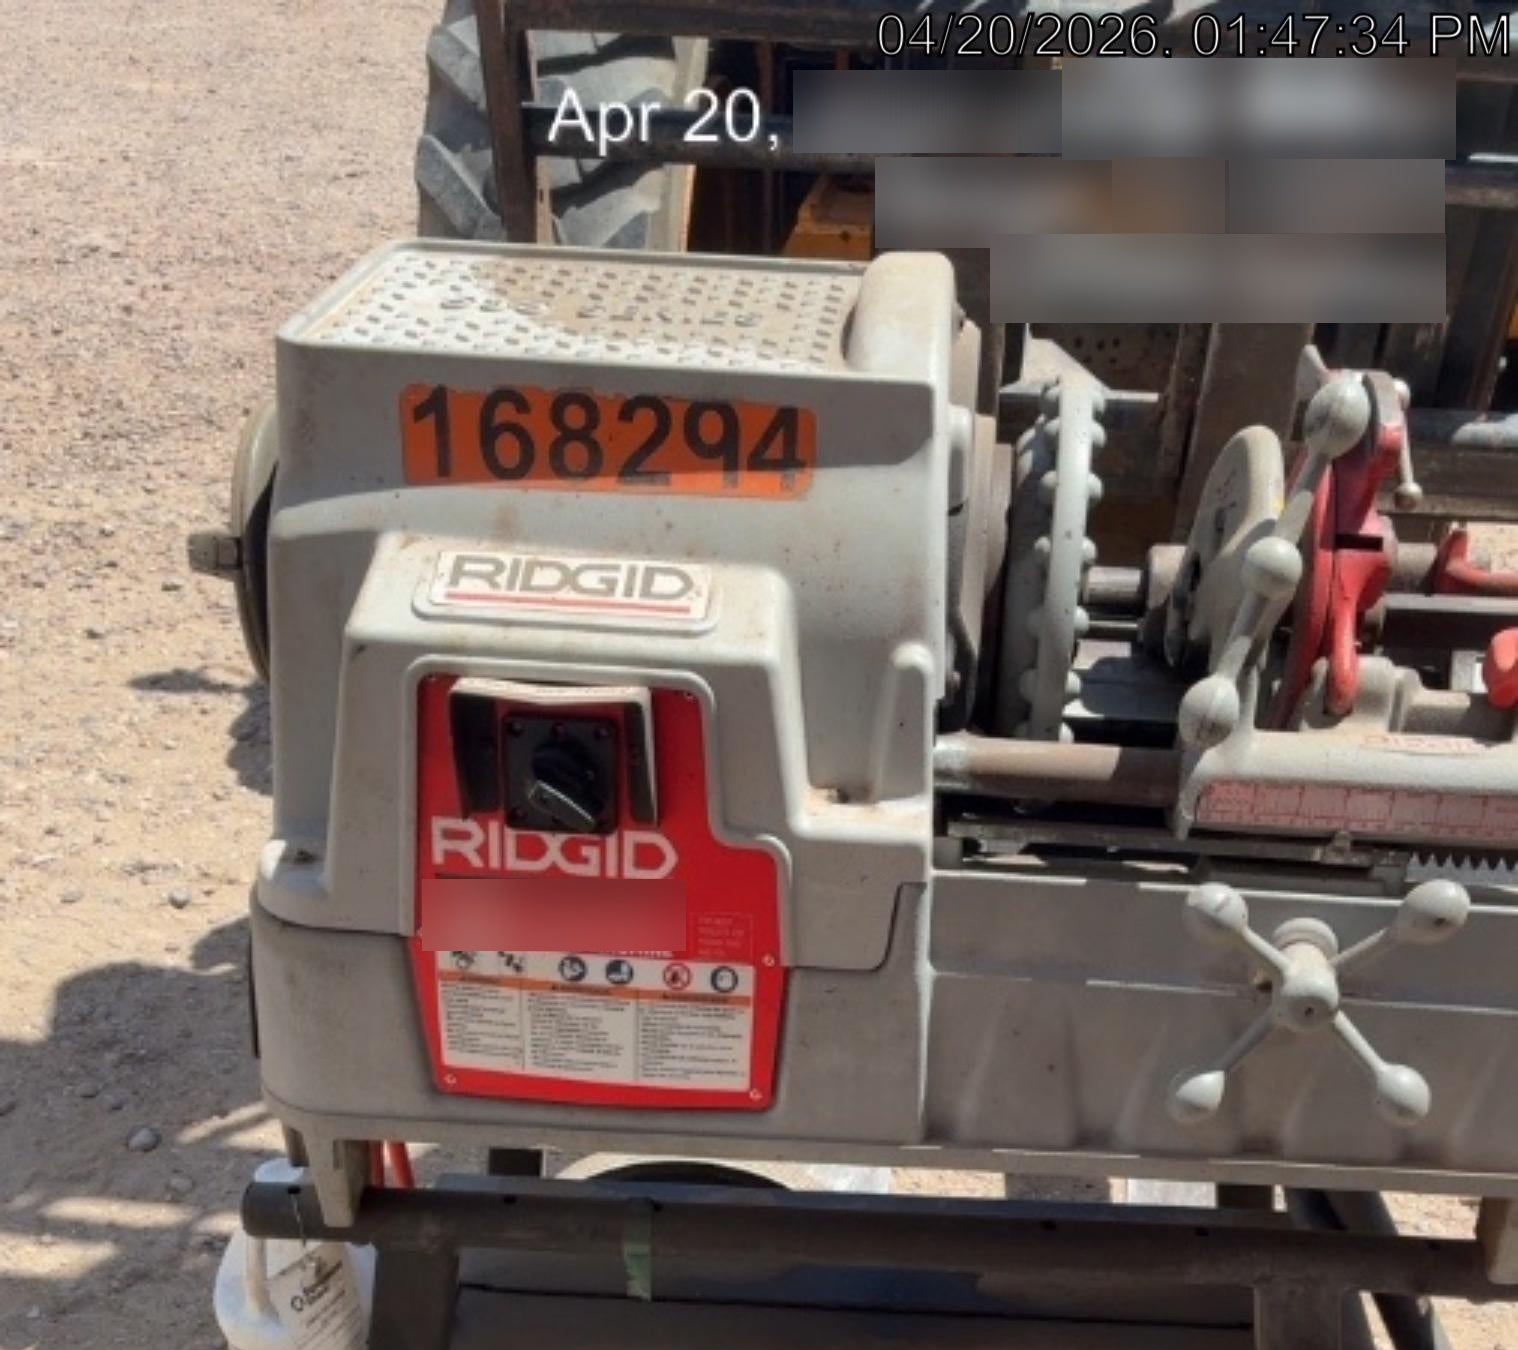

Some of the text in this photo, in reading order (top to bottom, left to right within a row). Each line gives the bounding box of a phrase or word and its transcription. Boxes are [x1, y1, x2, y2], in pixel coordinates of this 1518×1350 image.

[413, 384, 806, 491] 168294
[450, 554, 695, 600] RIDGID
[431, 815, 678, 880] RIDGID
